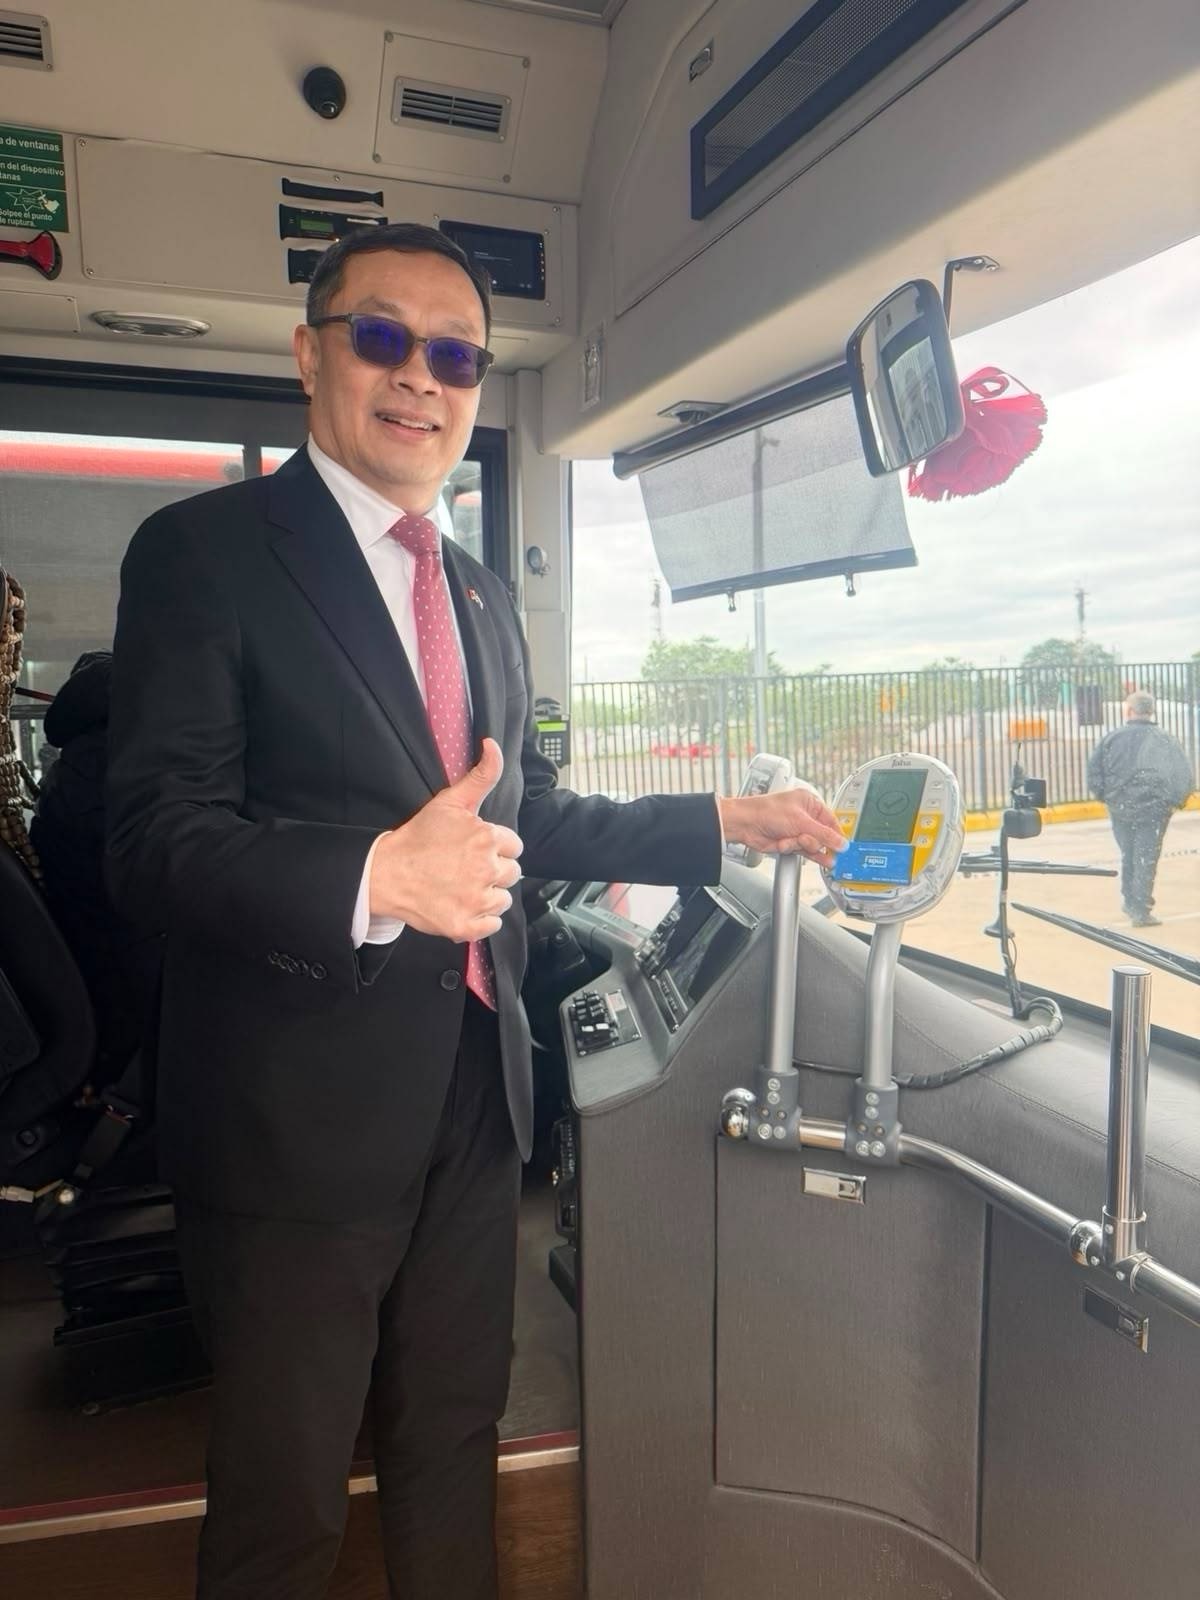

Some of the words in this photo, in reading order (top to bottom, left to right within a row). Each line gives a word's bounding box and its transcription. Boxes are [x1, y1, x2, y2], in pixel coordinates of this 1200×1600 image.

[5, 136, 17, 146] de
[18, 139, 60, 152] ventanas
[6, 162, 20, 171] del
[20, 163, 65, 176] dispositivo
[23, 211, 31, 219] el
[31, 213, 53, 222] punto
